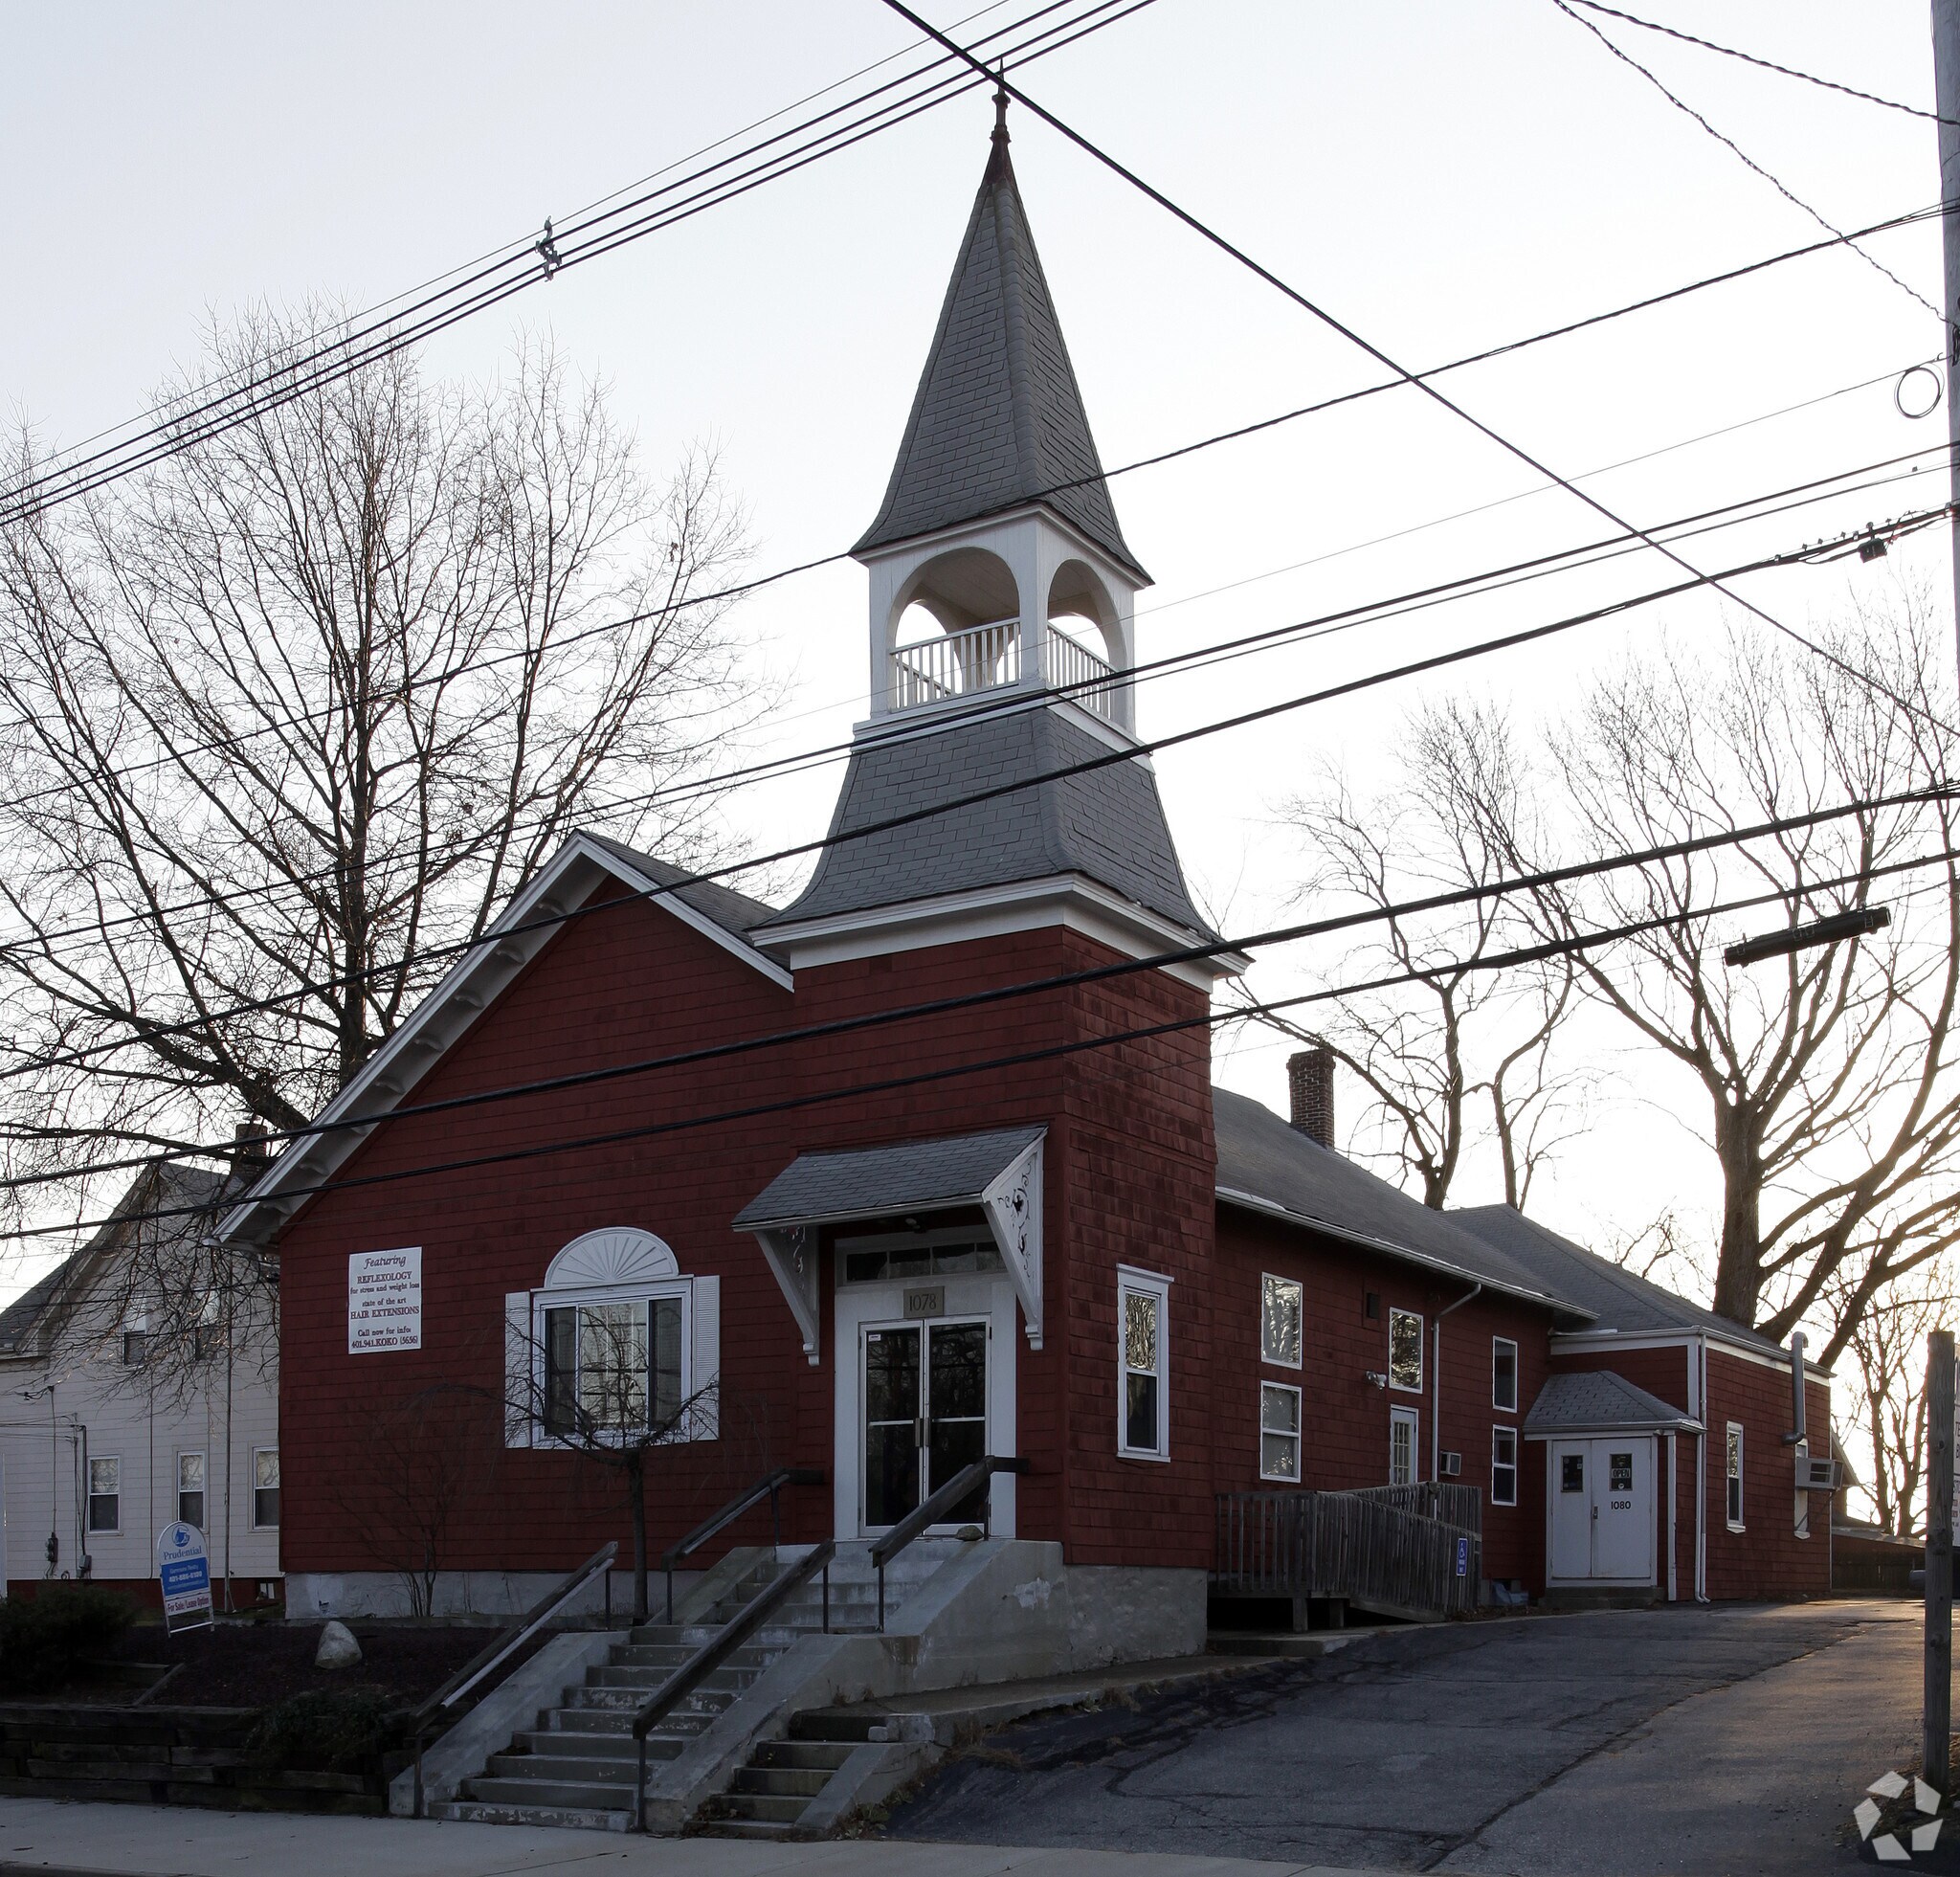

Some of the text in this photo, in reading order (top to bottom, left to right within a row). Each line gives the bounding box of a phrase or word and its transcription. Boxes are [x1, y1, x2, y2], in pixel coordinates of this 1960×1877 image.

[364, 1255, 407, 1269] Featuring
[357, 1271, 412, 1285] REFLEXOLOGY
[390, 1284, 408, 1292] weight
[909, 1293, 937, 1311] 1078
[350, 1306, 420, 1319] HAIR EXTENSIONS
[358, 1329, 369, 1337] Call
[1613, 1469, 1630, 1478] OPEN
[1611, 1501, 1631, 1509] 1080
[164, 1545, 202, 1560] Prudential
